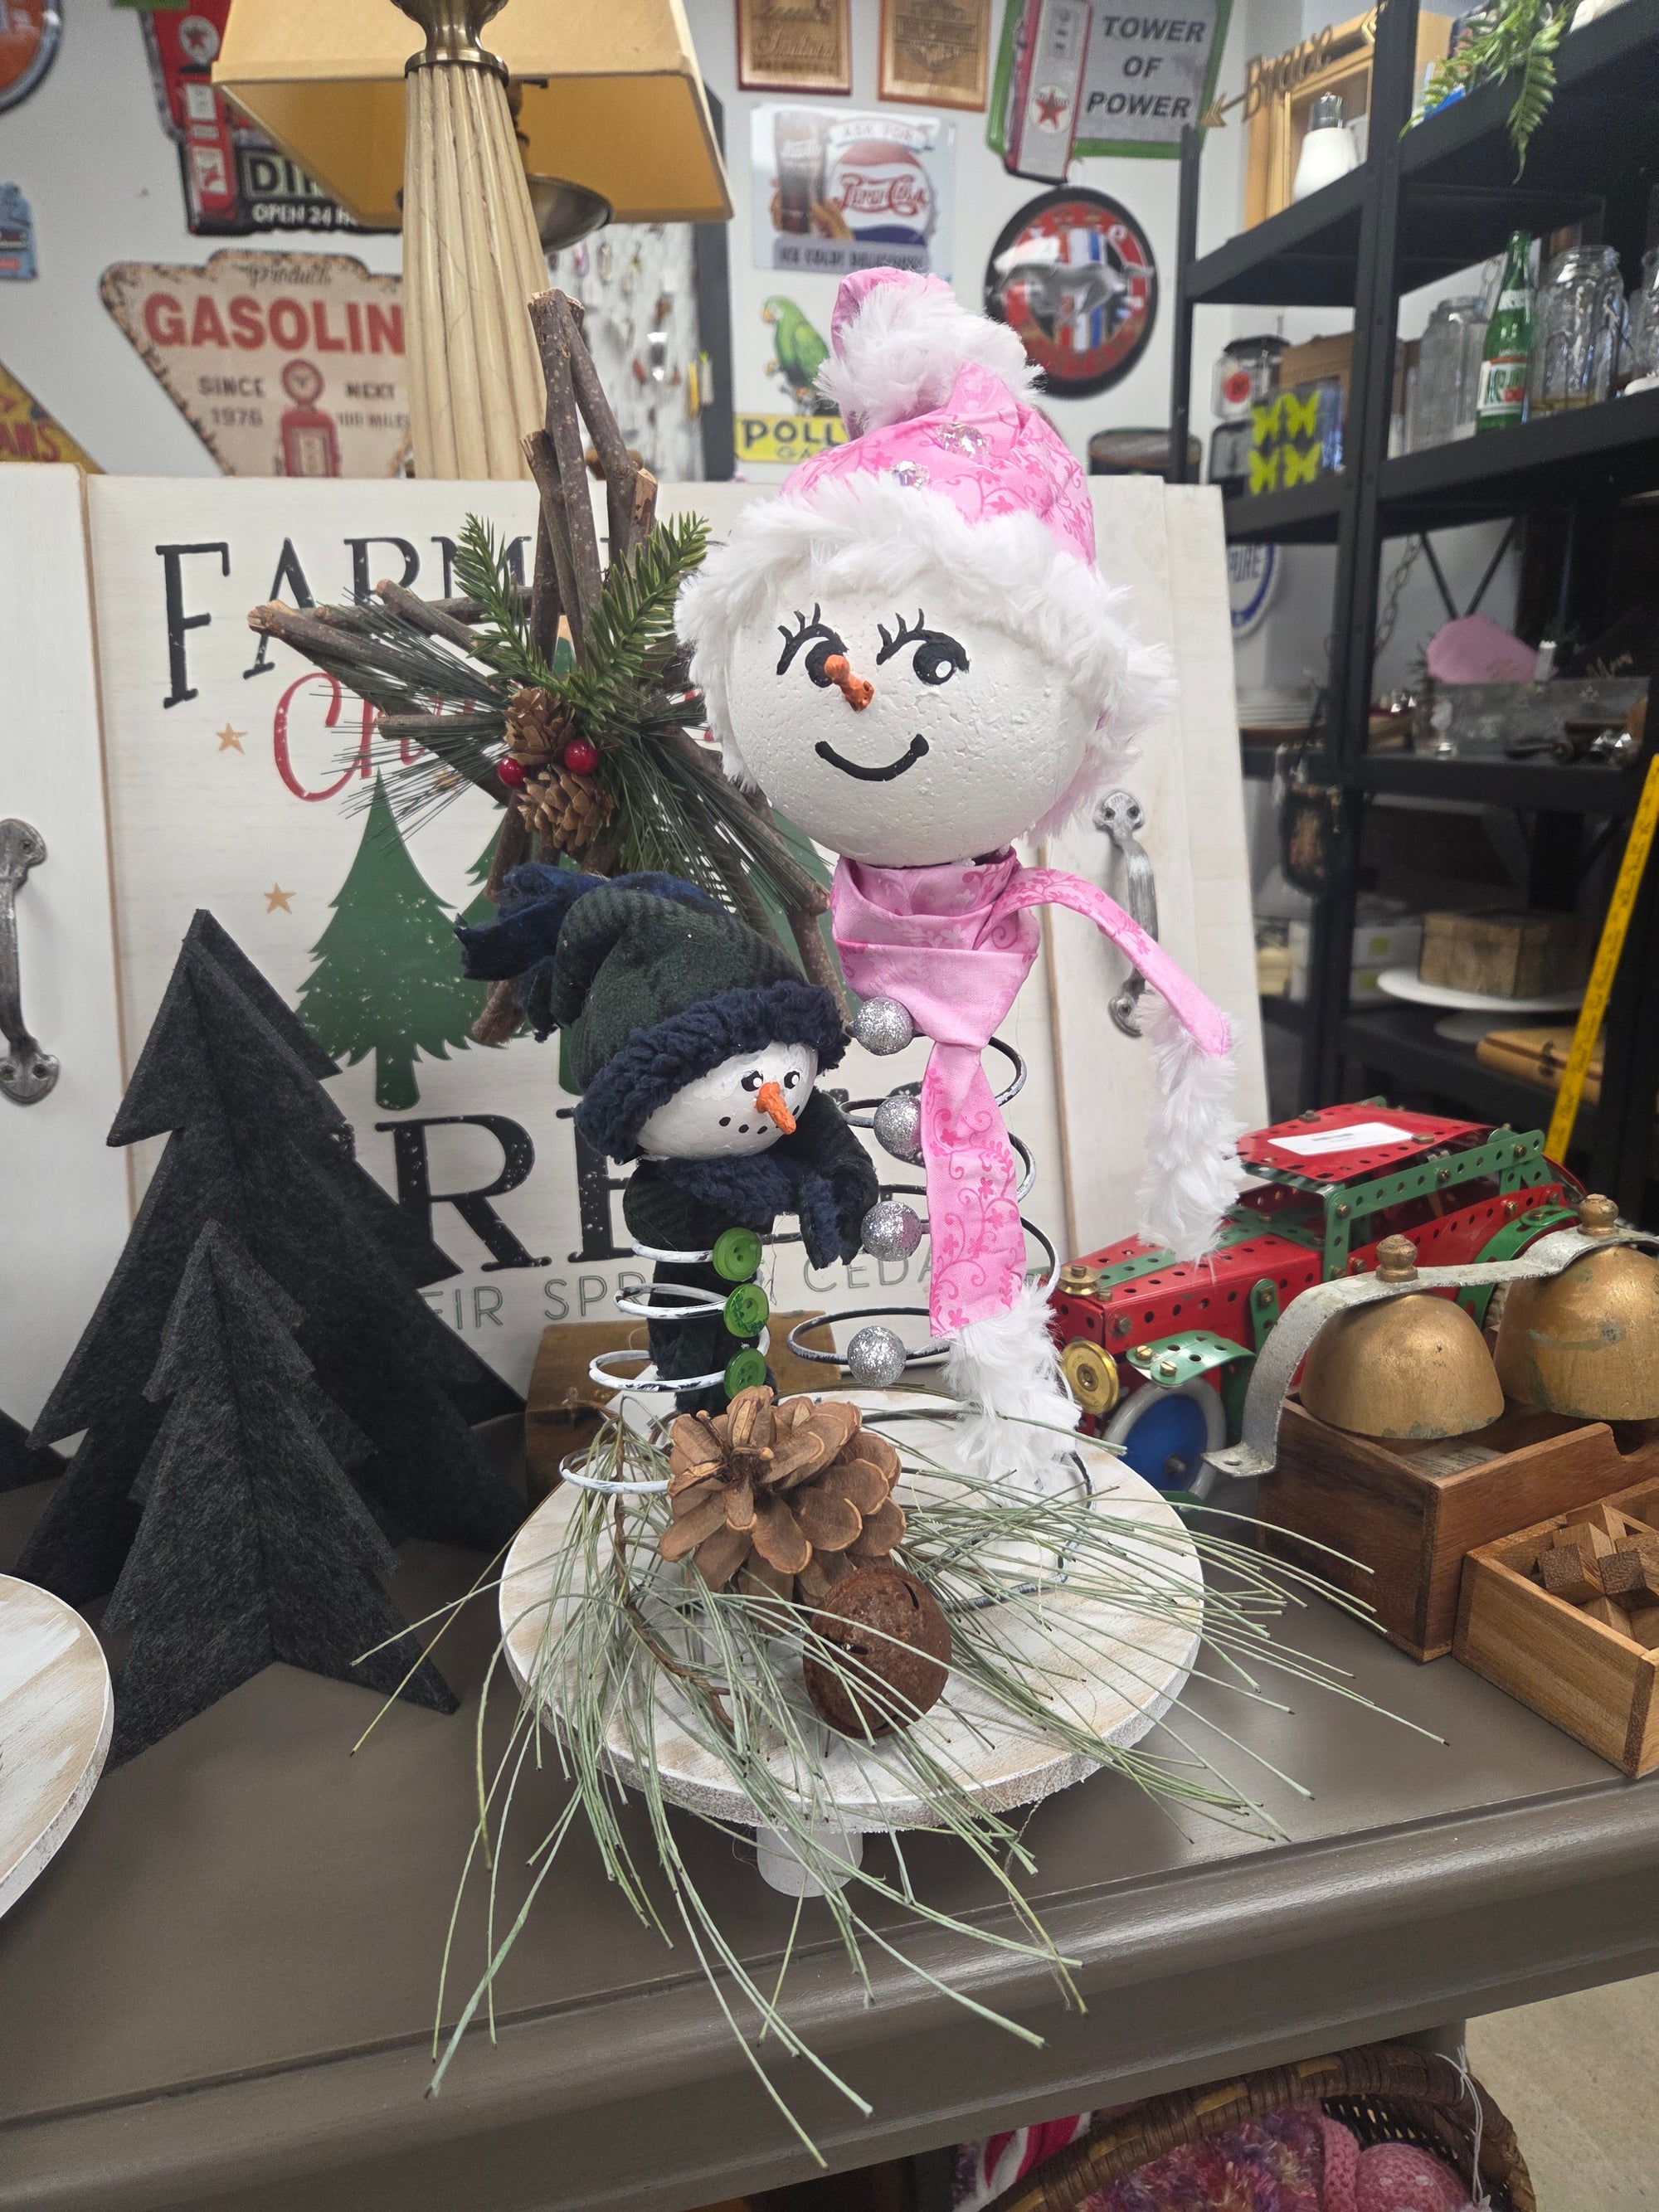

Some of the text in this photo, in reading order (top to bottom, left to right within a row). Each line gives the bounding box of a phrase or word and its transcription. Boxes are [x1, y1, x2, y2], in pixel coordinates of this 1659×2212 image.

[1102, 15, 1208, 42] TOWER
[1122, 55, 1163, 79] OF
[1087, 90, 1192, 119] POWER
[144, 292, 404, 355] GASOLIN
[198, 375, 265, 399] SINCE
[742, 419, 844, 449] POLL
